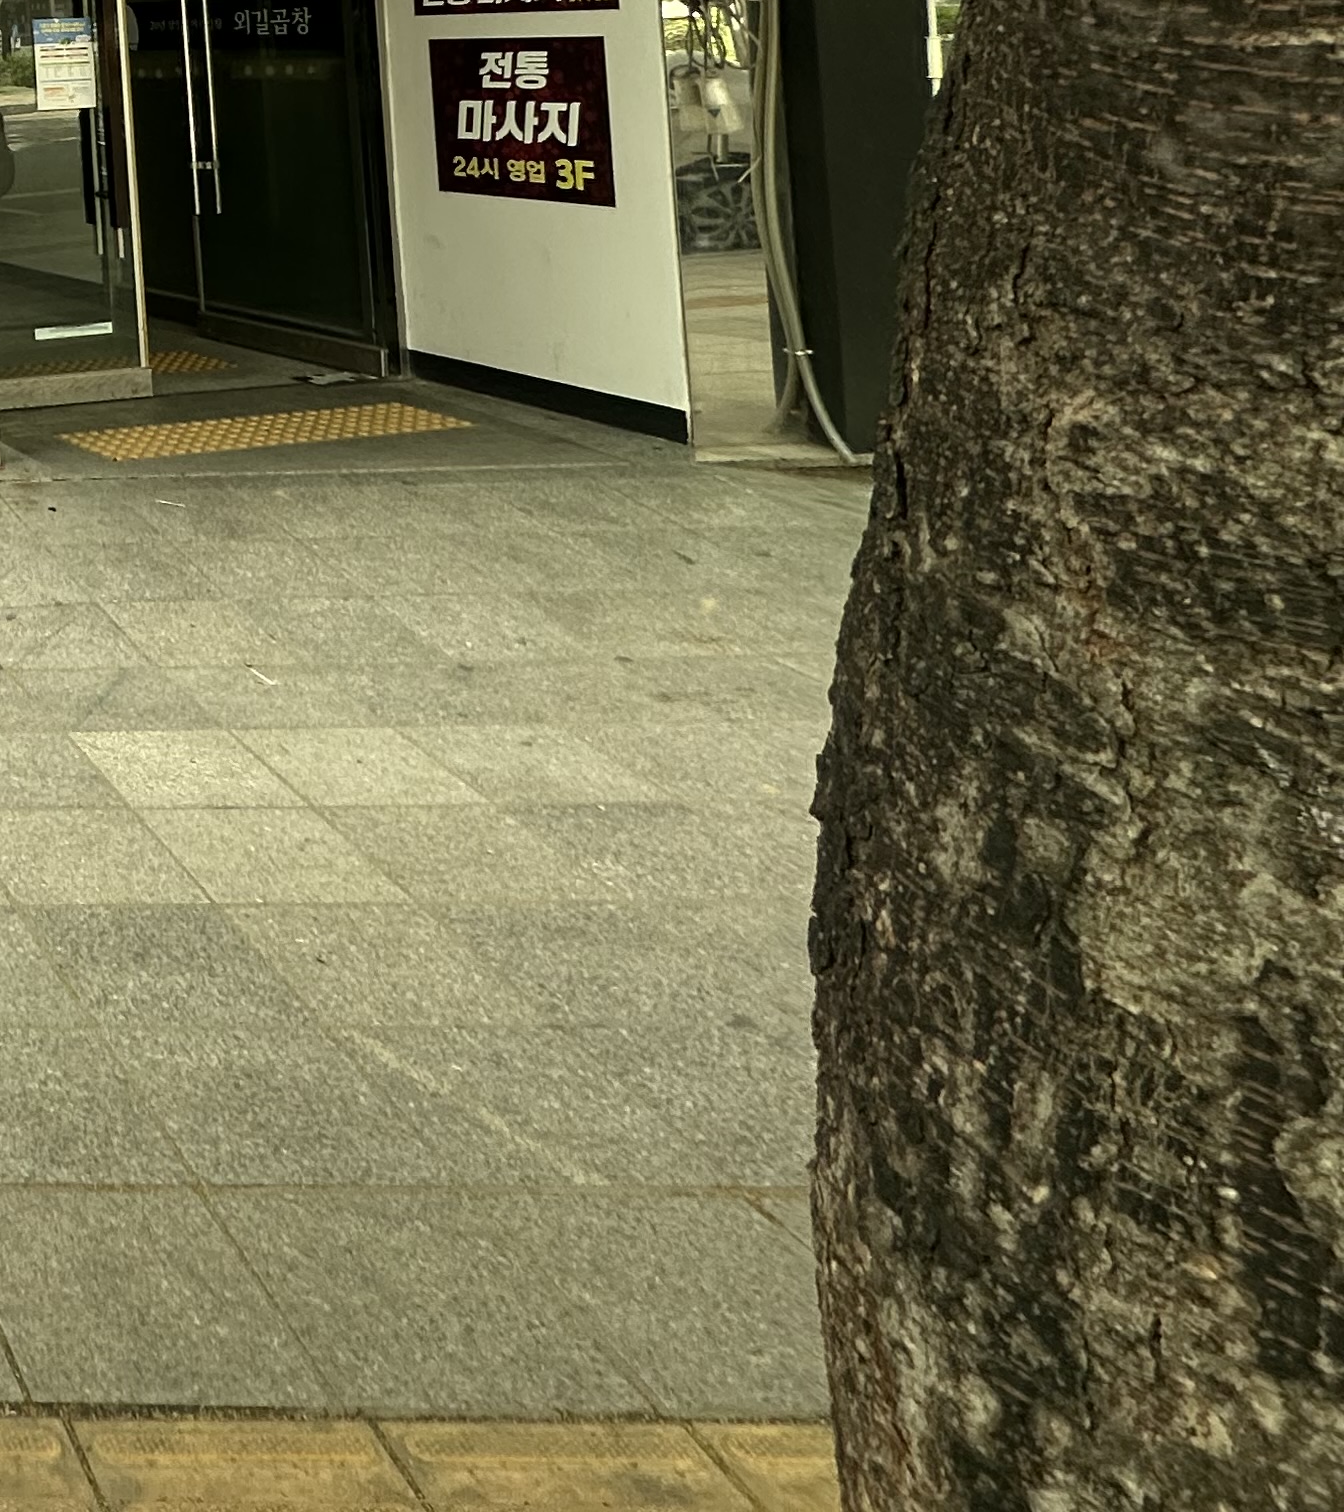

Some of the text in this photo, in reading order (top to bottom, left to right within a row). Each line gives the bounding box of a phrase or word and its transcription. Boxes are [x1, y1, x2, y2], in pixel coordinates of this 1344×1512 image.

[233, 6, 312, 35] 외길곱창
[478, 51, 549, 90] 전통
[457, 99, 582, 147] 마사지
[452, 155, 596, 191] 24시 영업 3F
